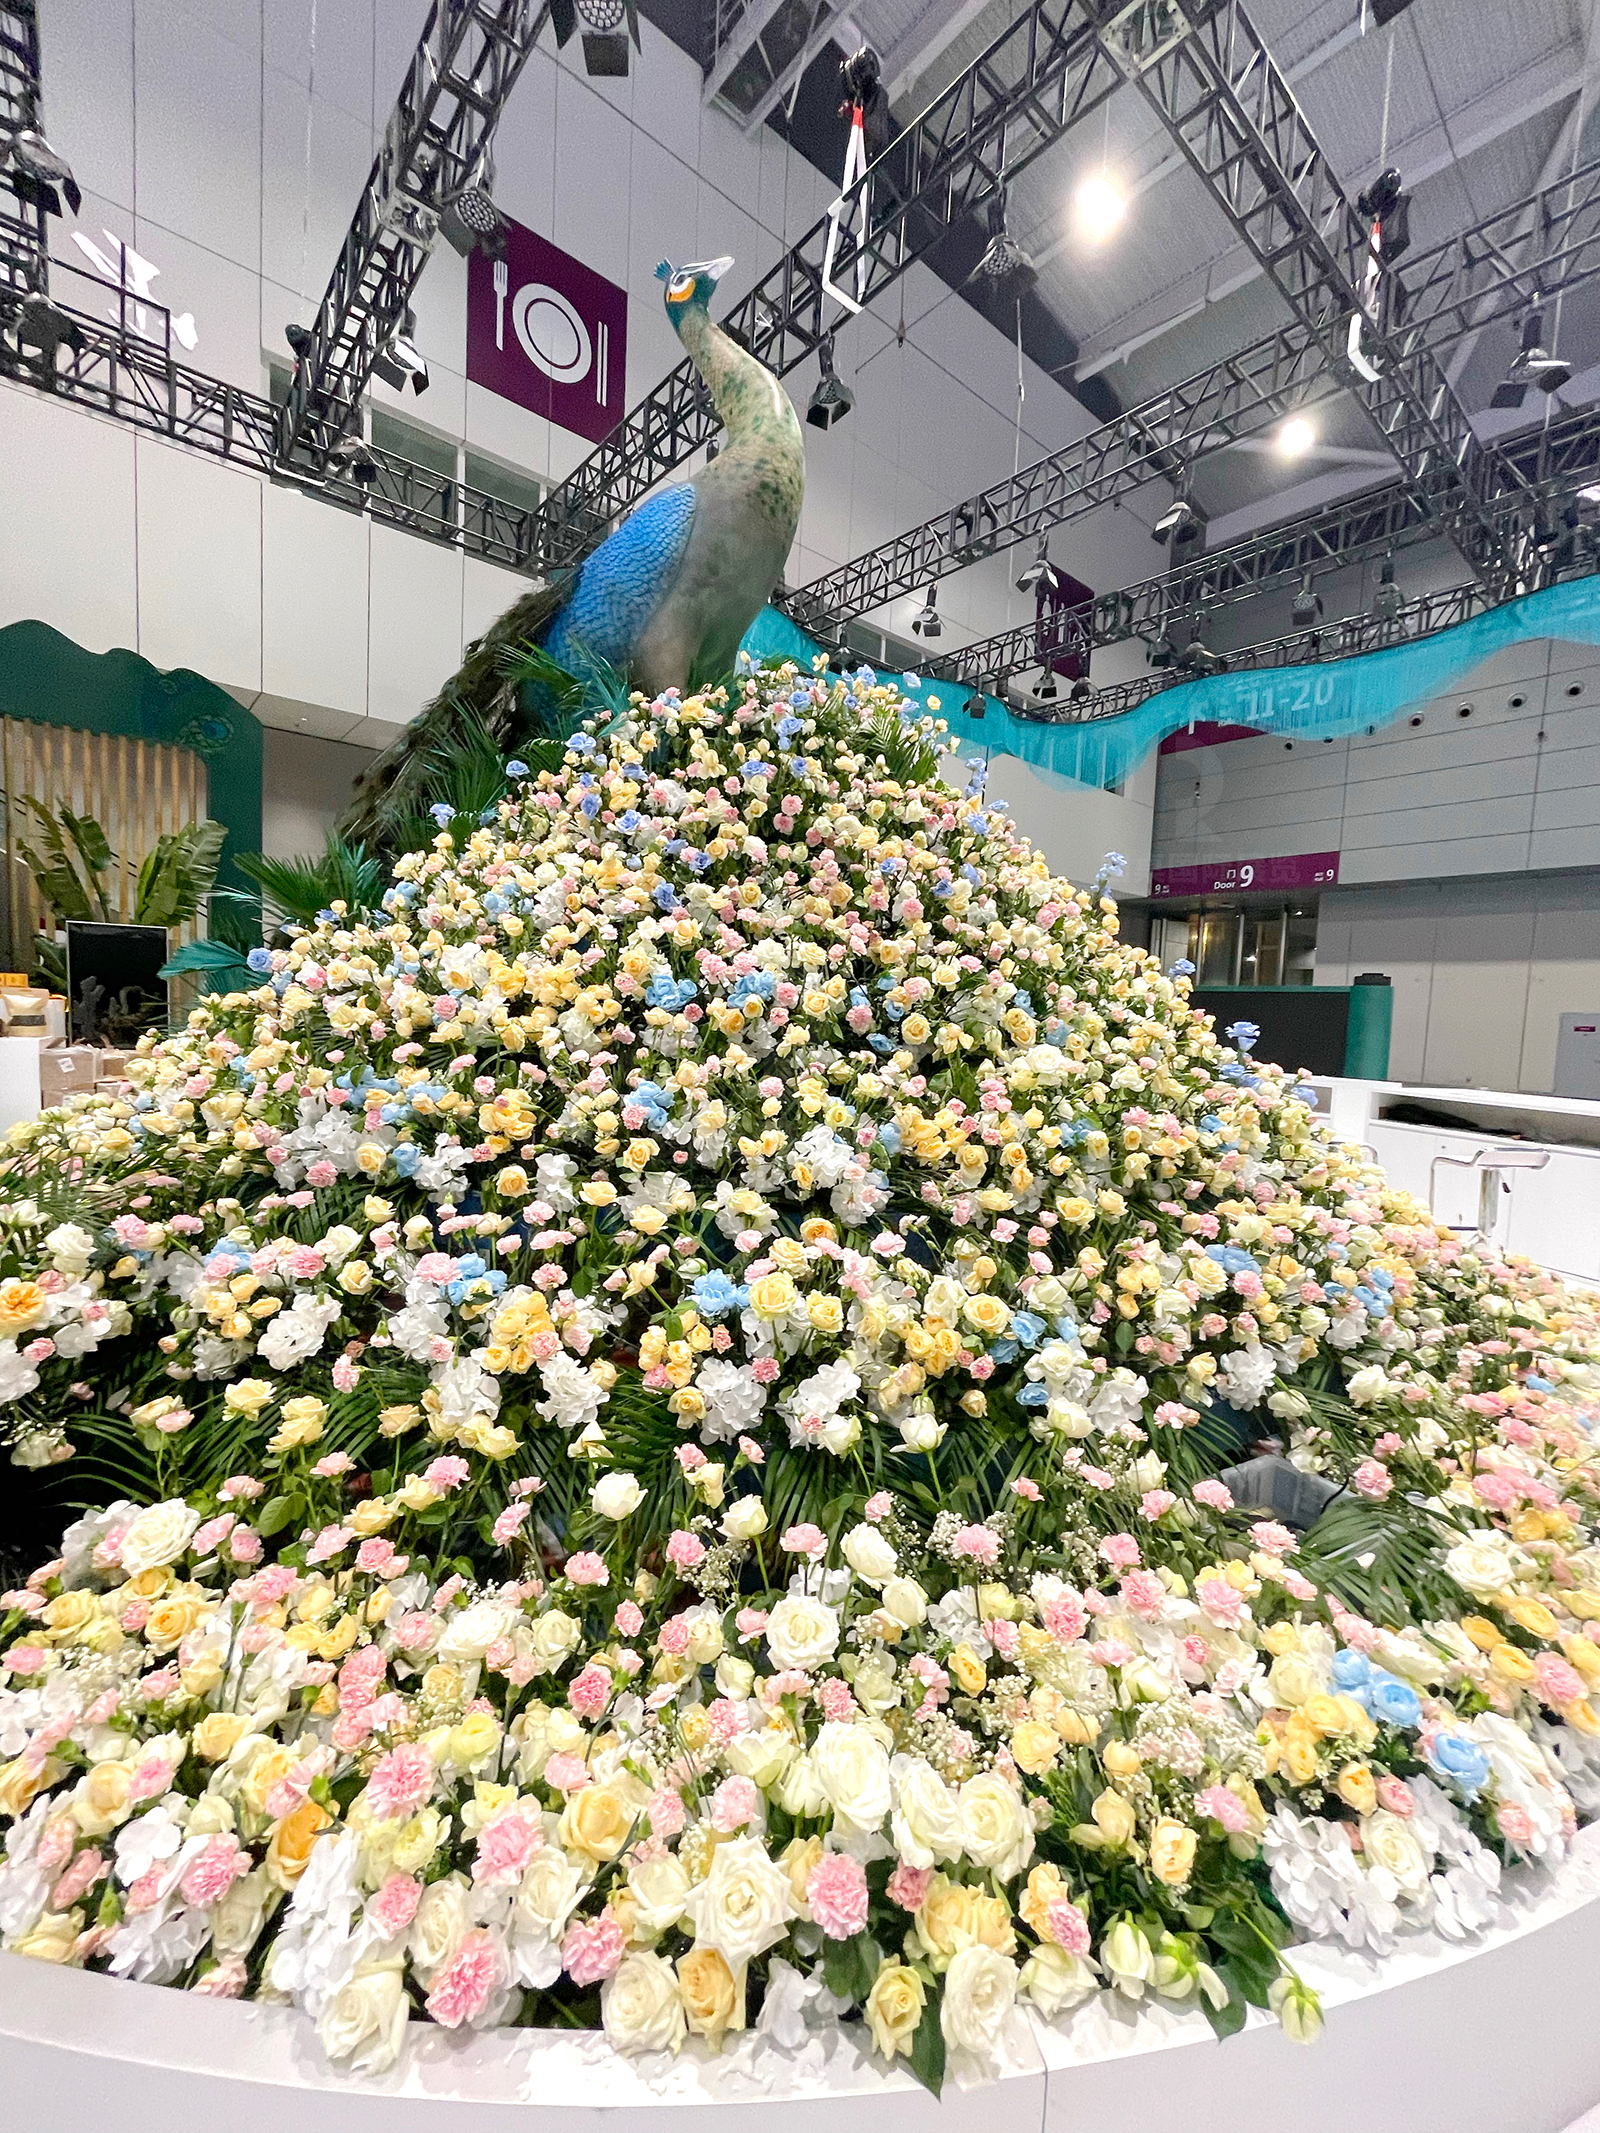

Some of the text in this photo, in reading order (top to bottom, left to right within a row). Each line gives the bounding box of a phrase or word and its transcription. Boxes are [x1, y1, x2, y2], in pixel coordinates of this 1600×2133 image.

[1213, 864, 1254, 890] Door 9
[1326, 868, 1335, 882] 9
